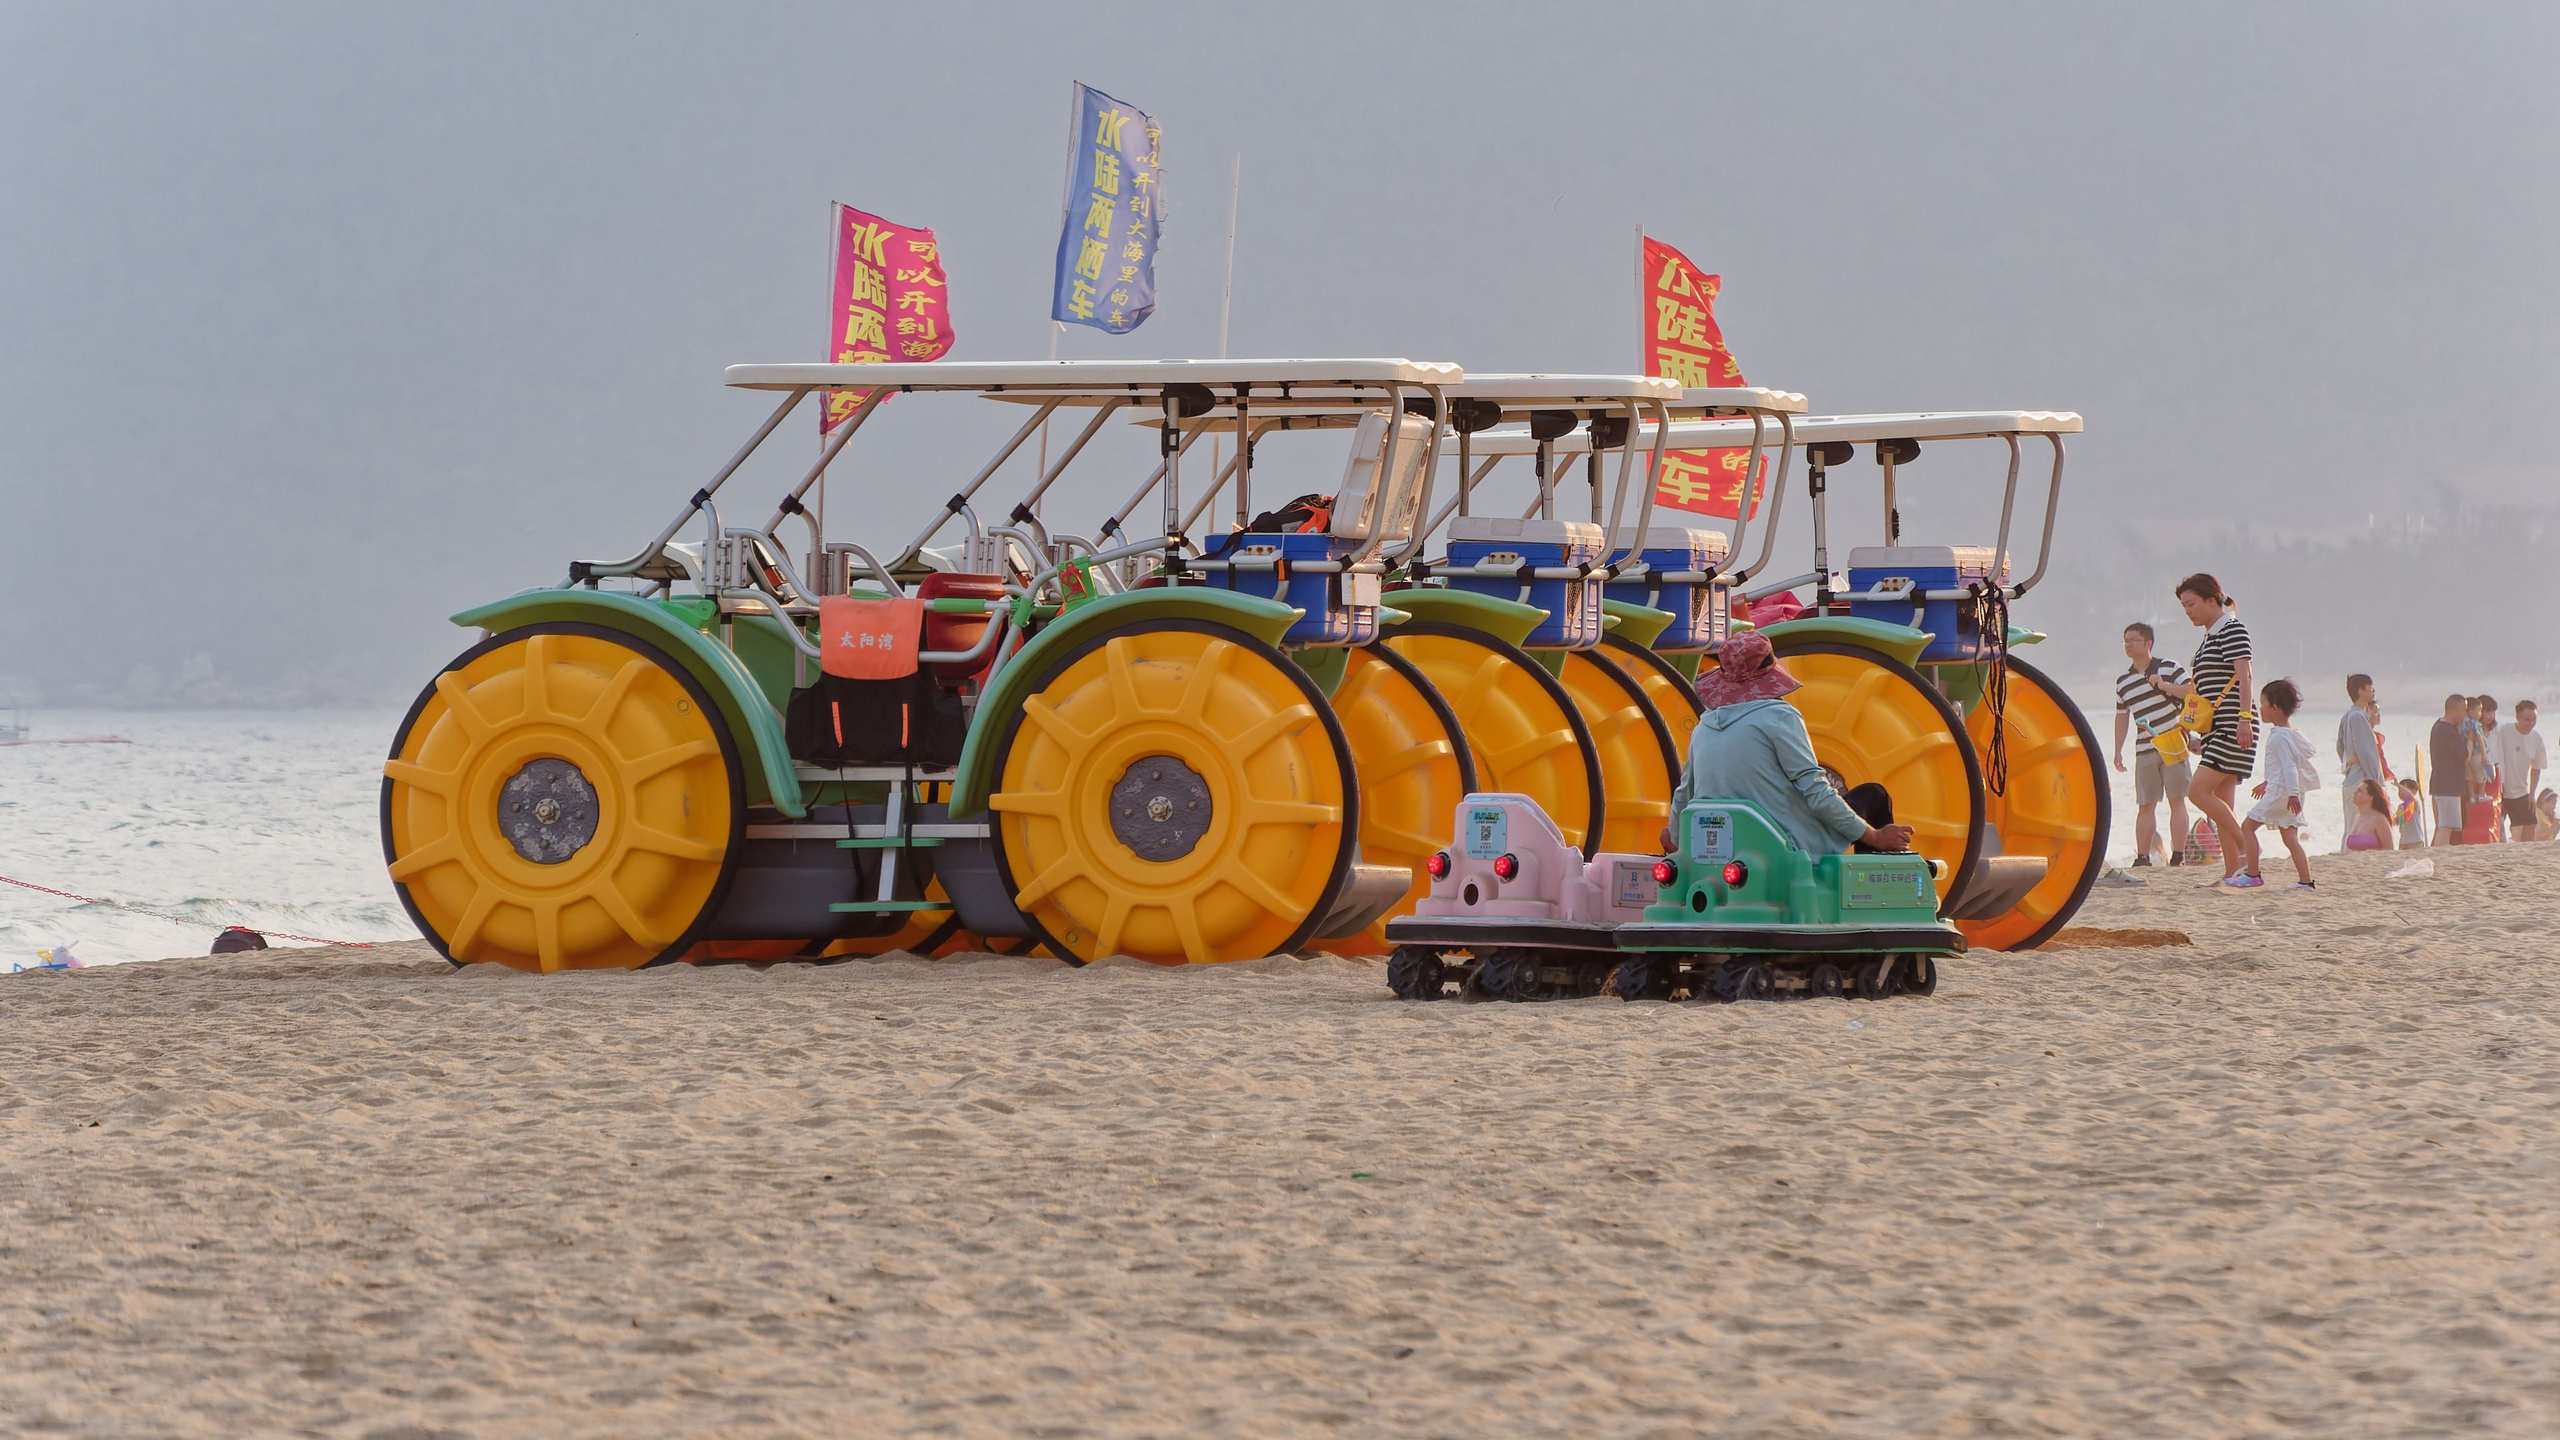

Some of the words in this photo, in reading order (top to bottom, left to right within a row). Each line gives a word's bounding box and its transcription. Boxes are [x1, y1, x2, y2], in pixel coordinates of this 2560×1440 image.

[1068, 109, 1130, 320] 水陆两栖车
[839, 630, 894, 652] 太阳湾
